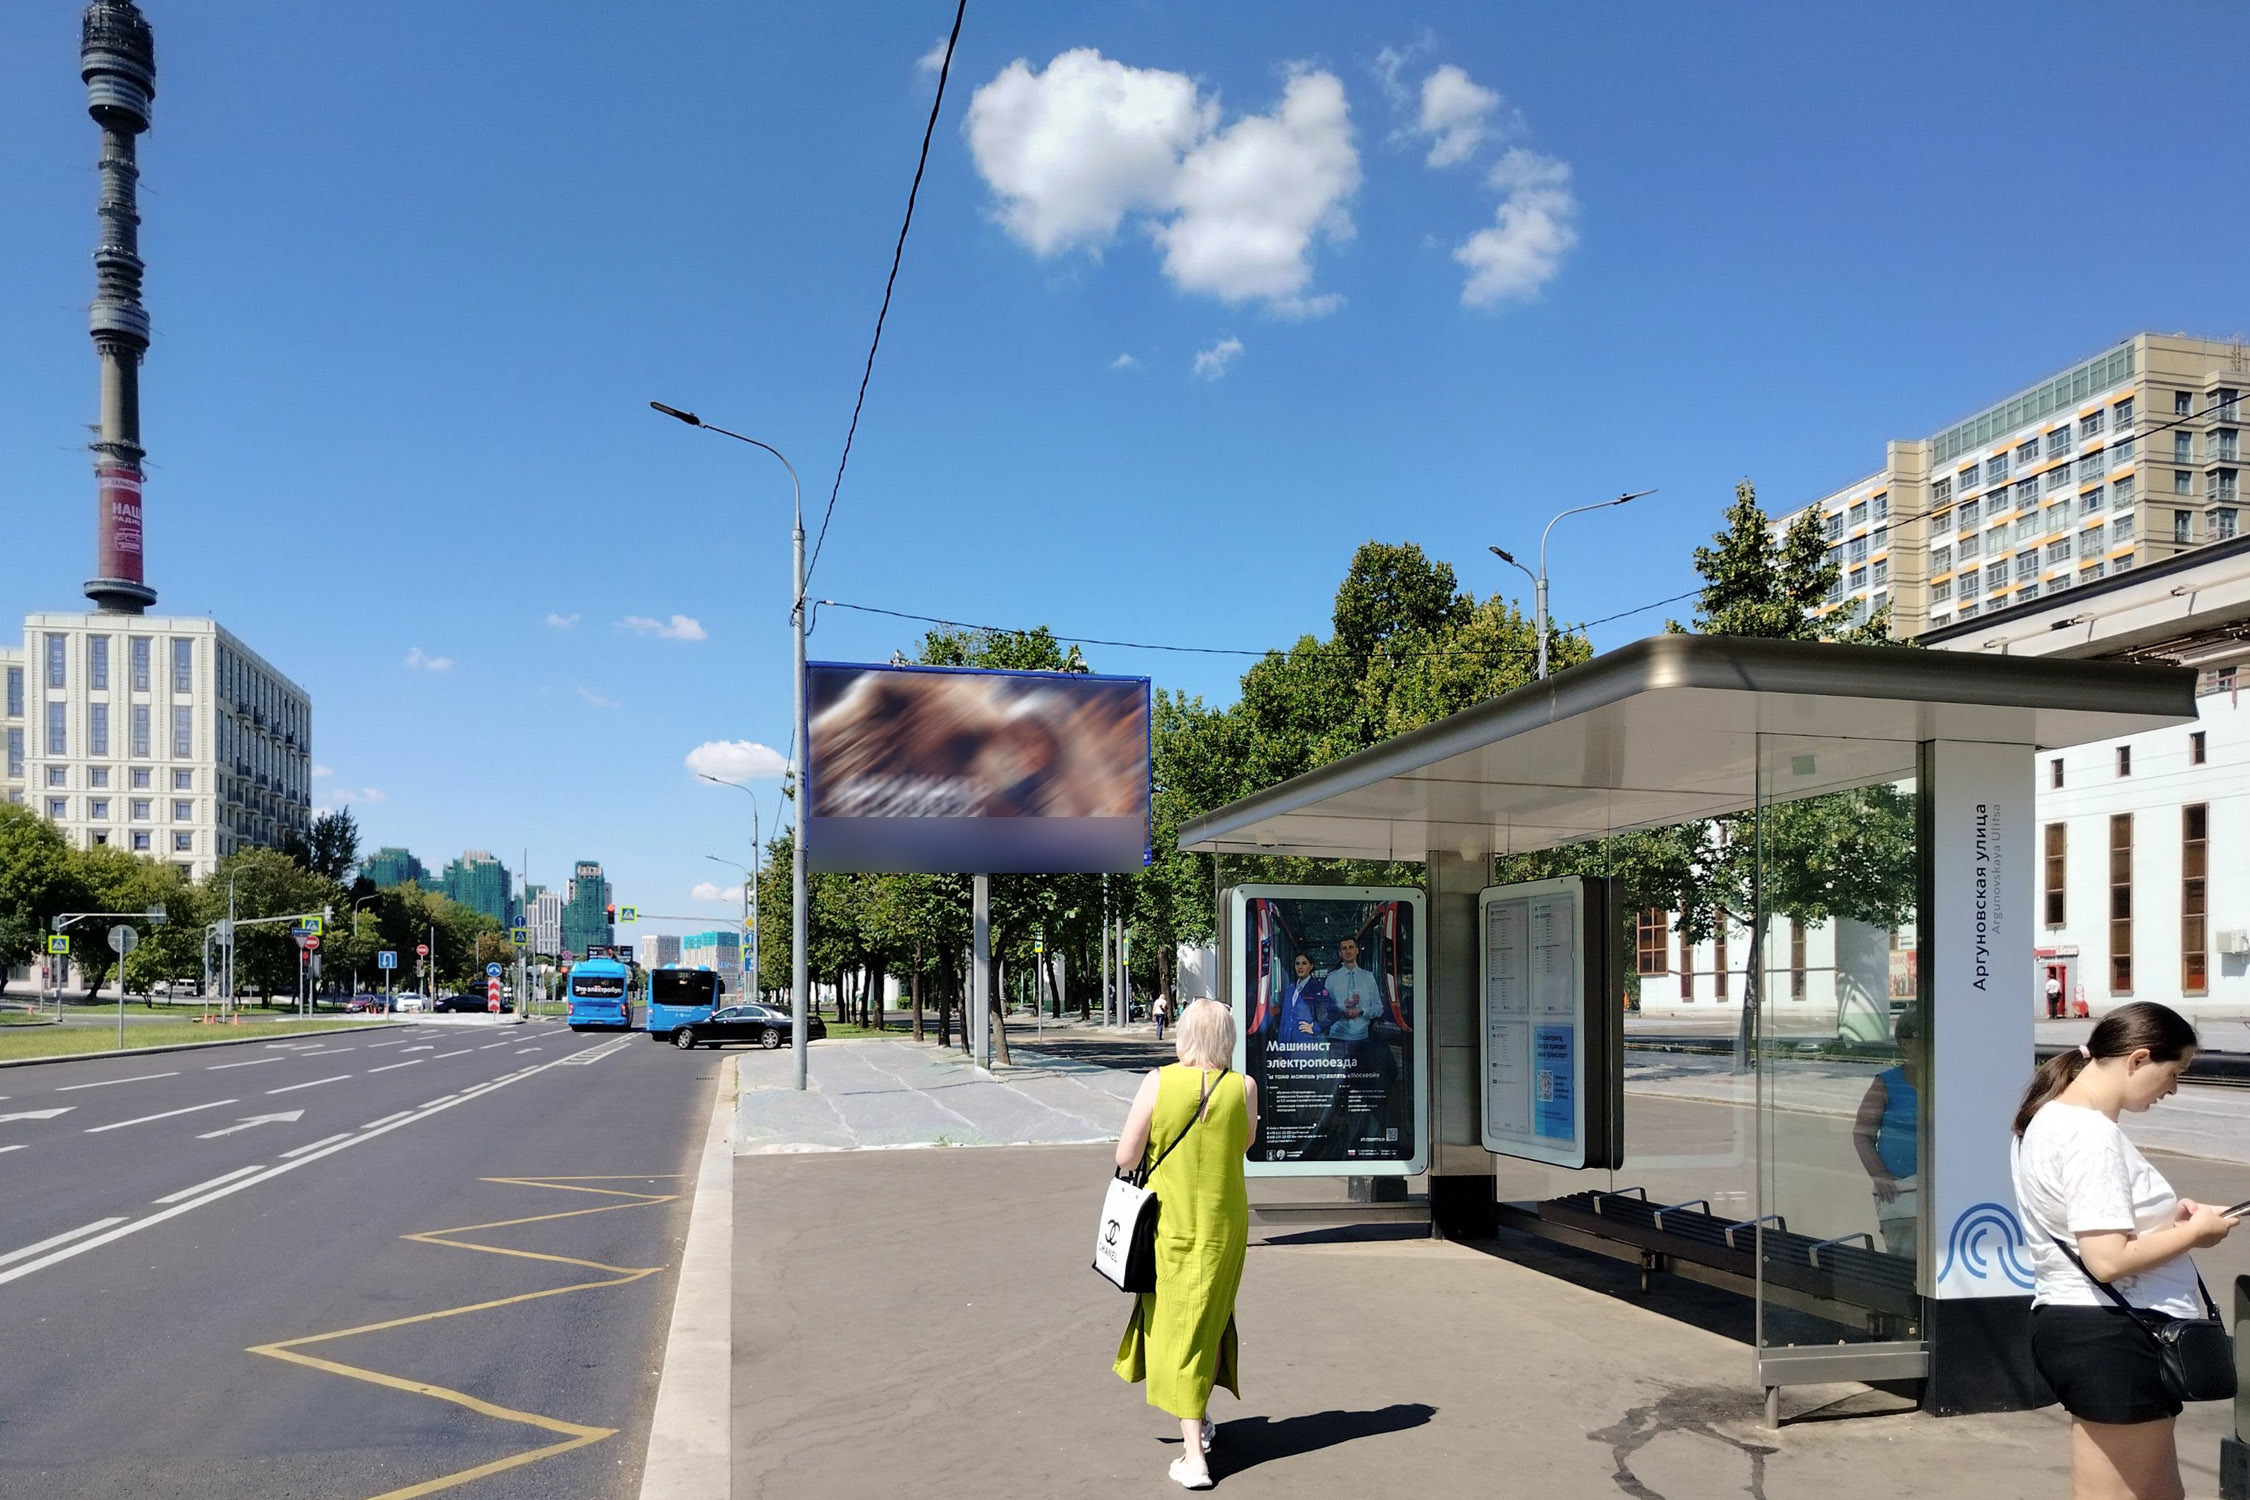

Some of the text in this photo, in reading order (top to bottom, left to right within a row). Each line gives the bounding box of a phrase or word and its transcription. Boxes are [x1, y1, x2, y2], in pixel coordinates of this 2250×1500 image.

[1991, 804, 2003, 935] Argunovskaya Ulitsa
[1973, 804, 1989, 991] Аргуновская улица
[1266, 1040, 1331, 1052] Машинист
[1266, 1058, 1358, 1071] электропоезда
[1316, 1072, 1347, 1080] управлять
